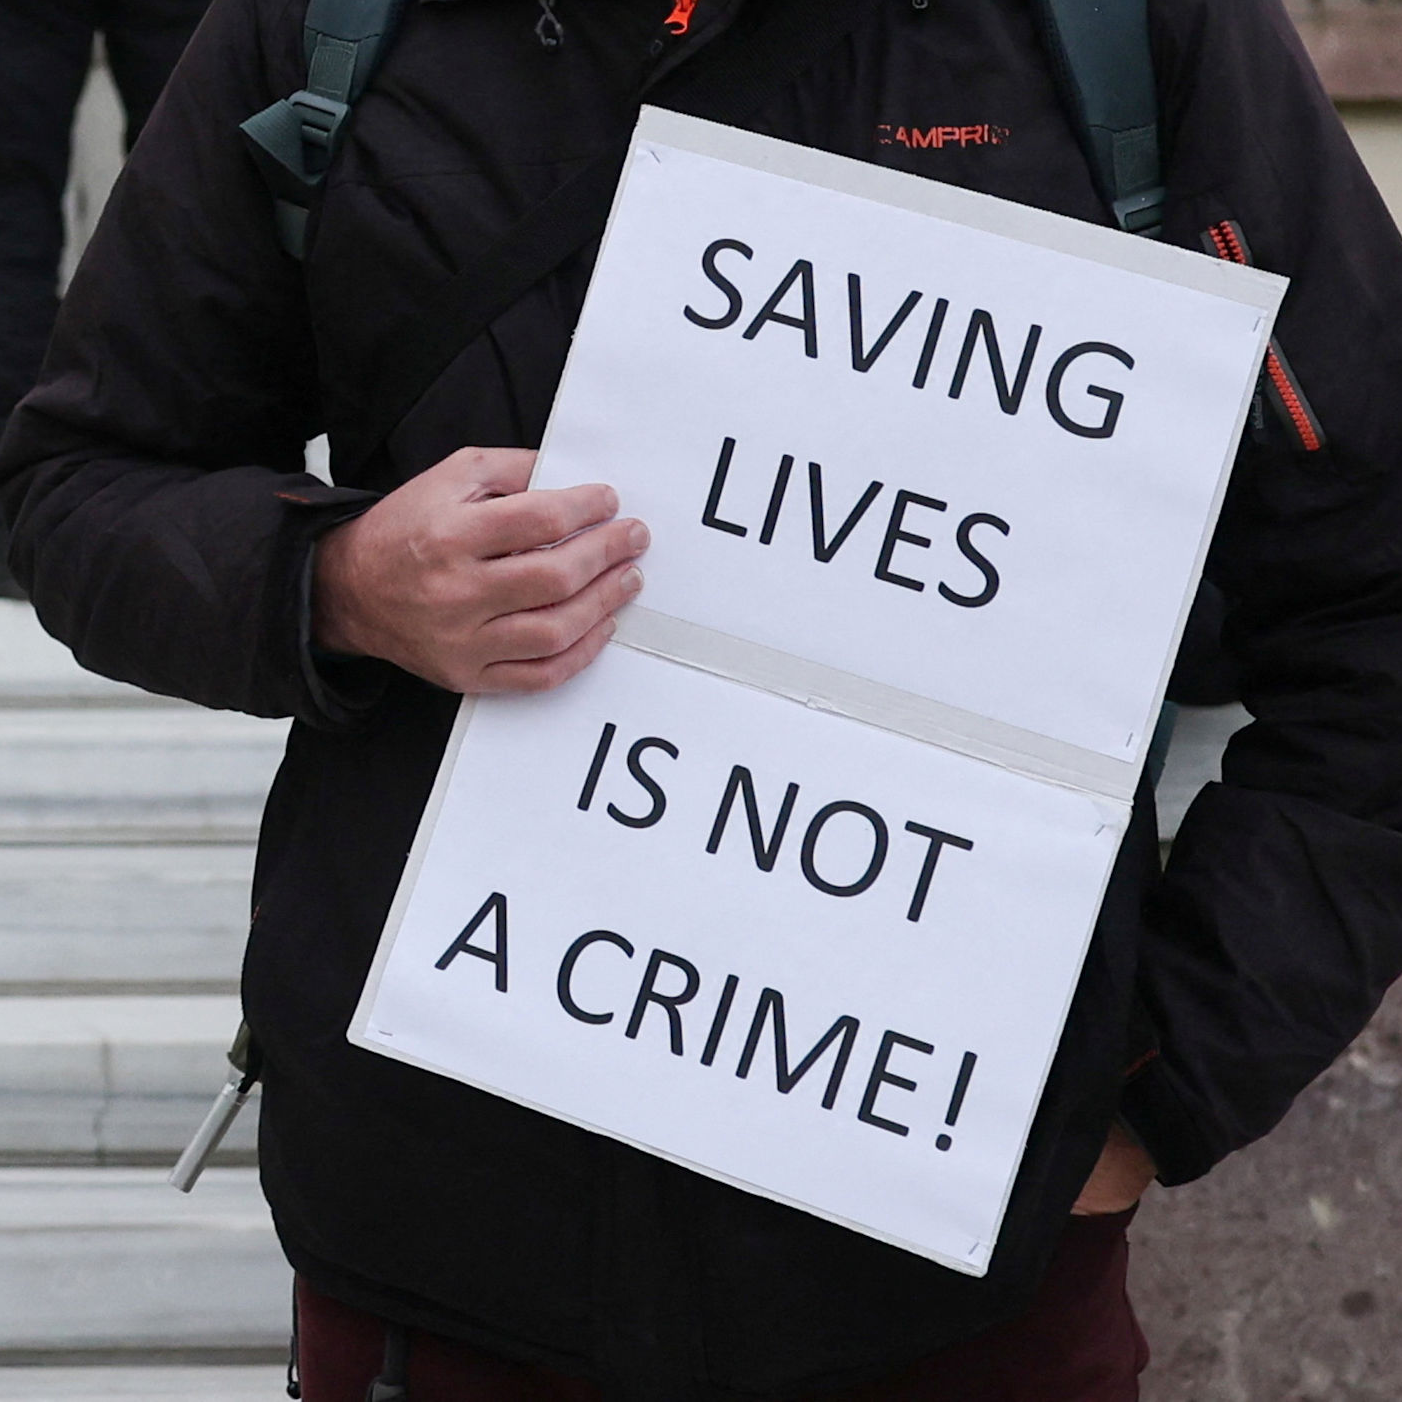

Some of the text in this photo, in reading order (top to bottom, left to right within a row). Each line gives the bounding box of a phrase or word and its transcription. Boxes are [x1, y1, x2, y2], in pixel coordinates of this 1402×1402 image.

[683, 238, 1136, 440] SAVING
[701, 436, 1012, 609] LIVES
[577, 722, 975, 924] IS NOT
[434, 891, 979, 1153] A CRIME!
